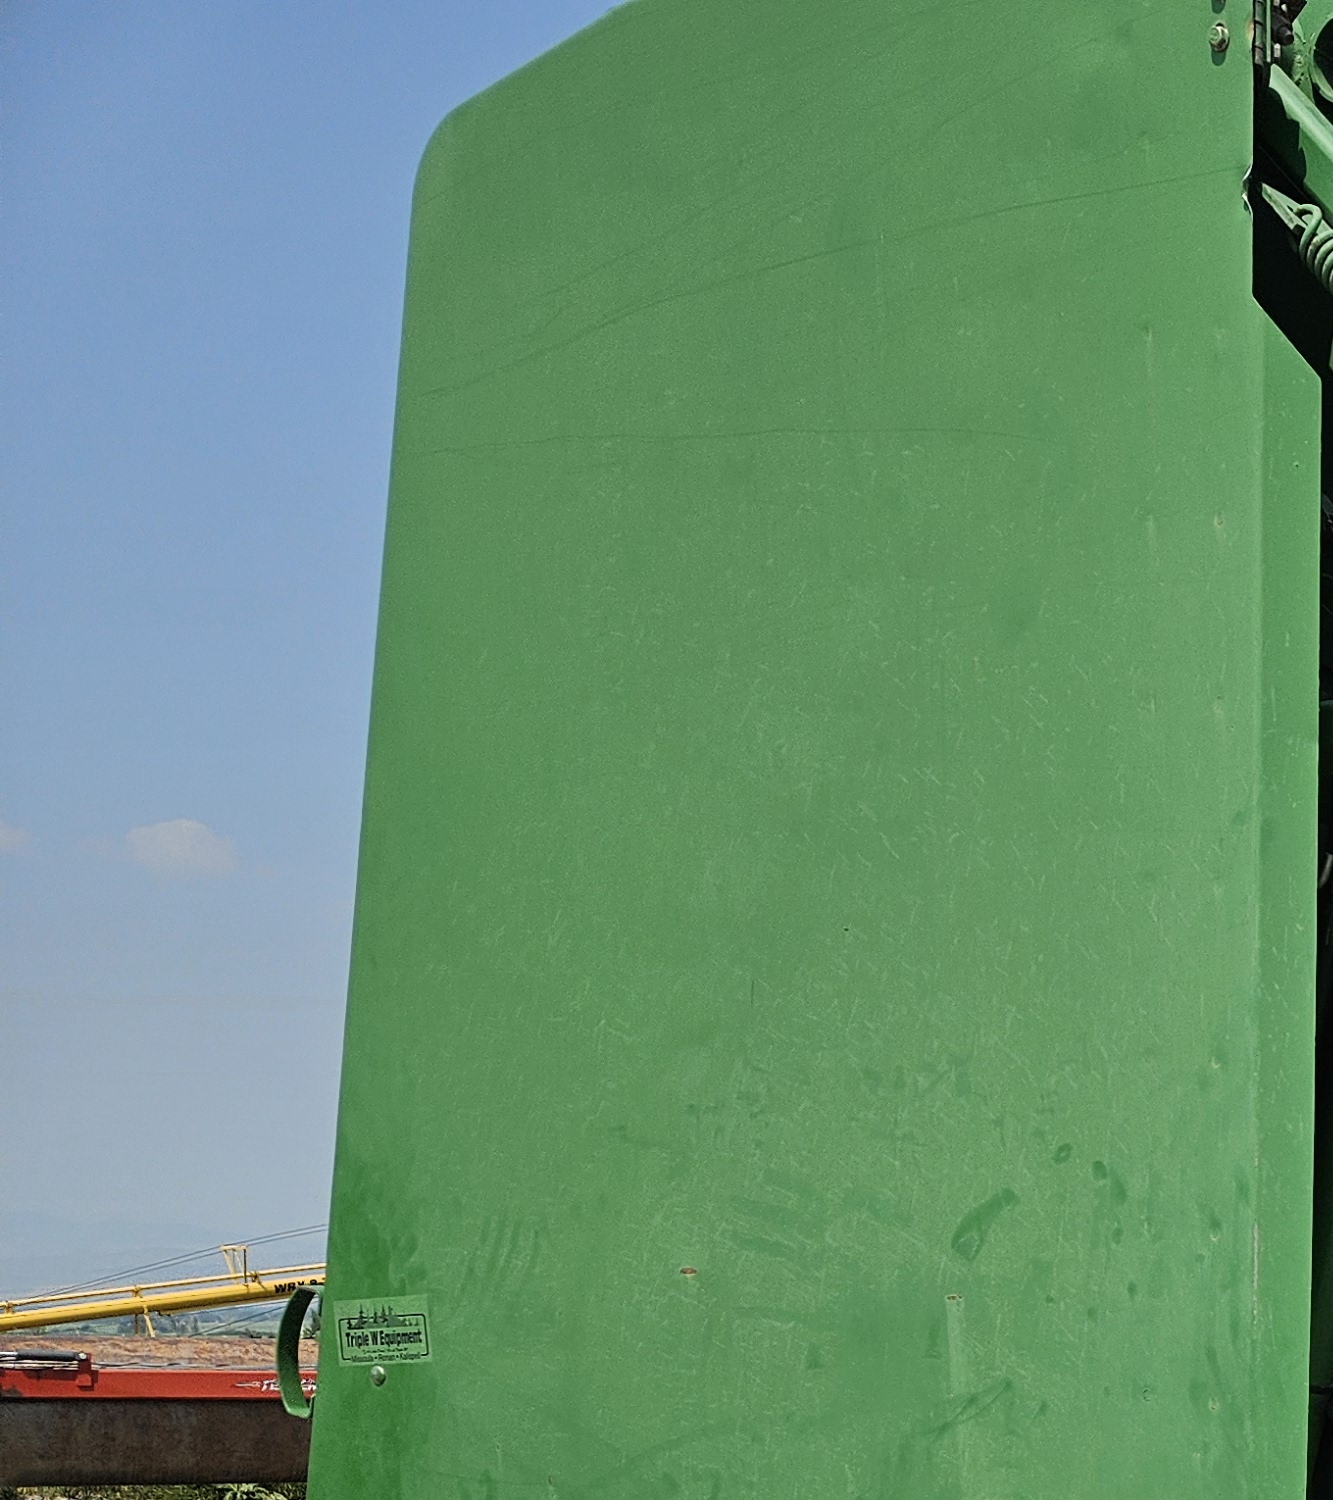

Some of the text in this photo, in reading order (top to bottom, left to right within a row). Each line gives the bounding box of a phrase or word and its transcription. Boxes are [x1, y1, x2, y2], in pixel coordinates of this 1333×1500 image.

[345, 1329, 422, 1349] Triple W Equipment
